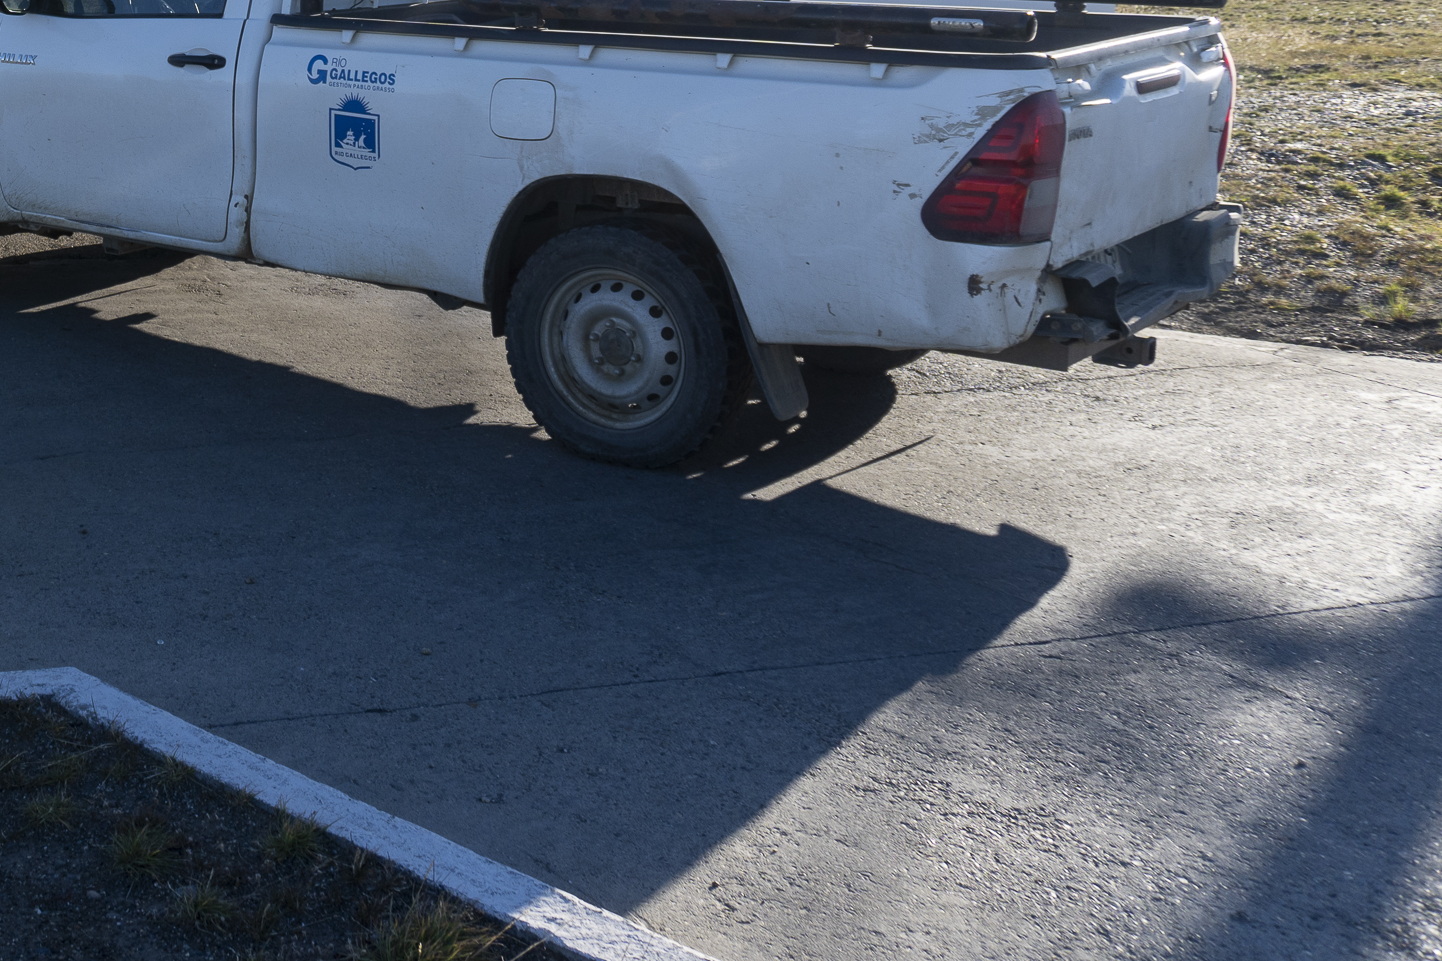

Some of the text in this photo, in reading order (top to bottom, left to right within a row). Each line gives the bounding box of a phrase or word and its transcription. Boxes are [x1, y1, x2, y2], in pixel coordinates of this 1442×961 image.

[329, 68, 396, 86] GALLEGOS
[353, 83, 371, 91] PABLO
[372, 85, 395, 93] GRASSO
[345, 151, 377, 162] GALLEGOS
